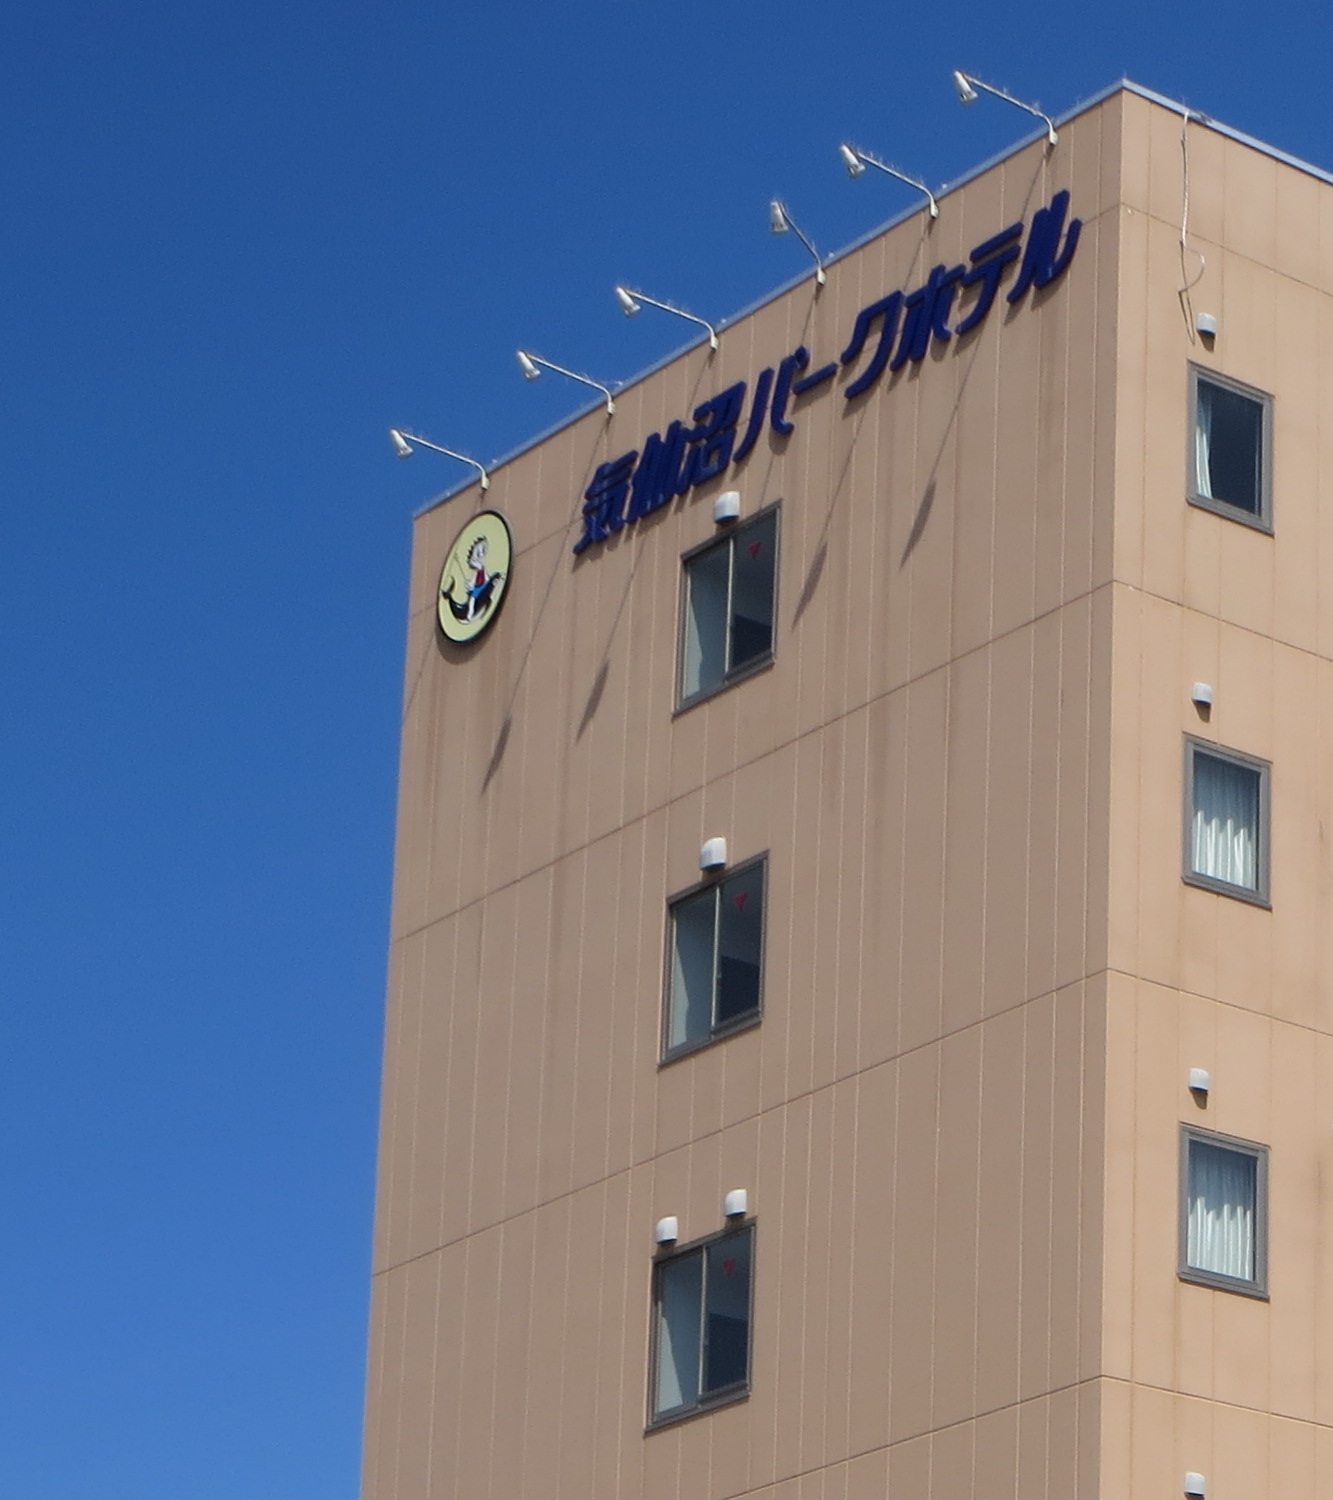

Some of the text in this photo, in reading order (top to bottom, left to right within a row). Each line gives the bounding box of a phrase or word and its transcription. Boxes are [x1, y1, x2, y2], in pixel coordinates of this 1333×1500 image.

[574, 190, 1082, 554] 気仙沼パークホテル
